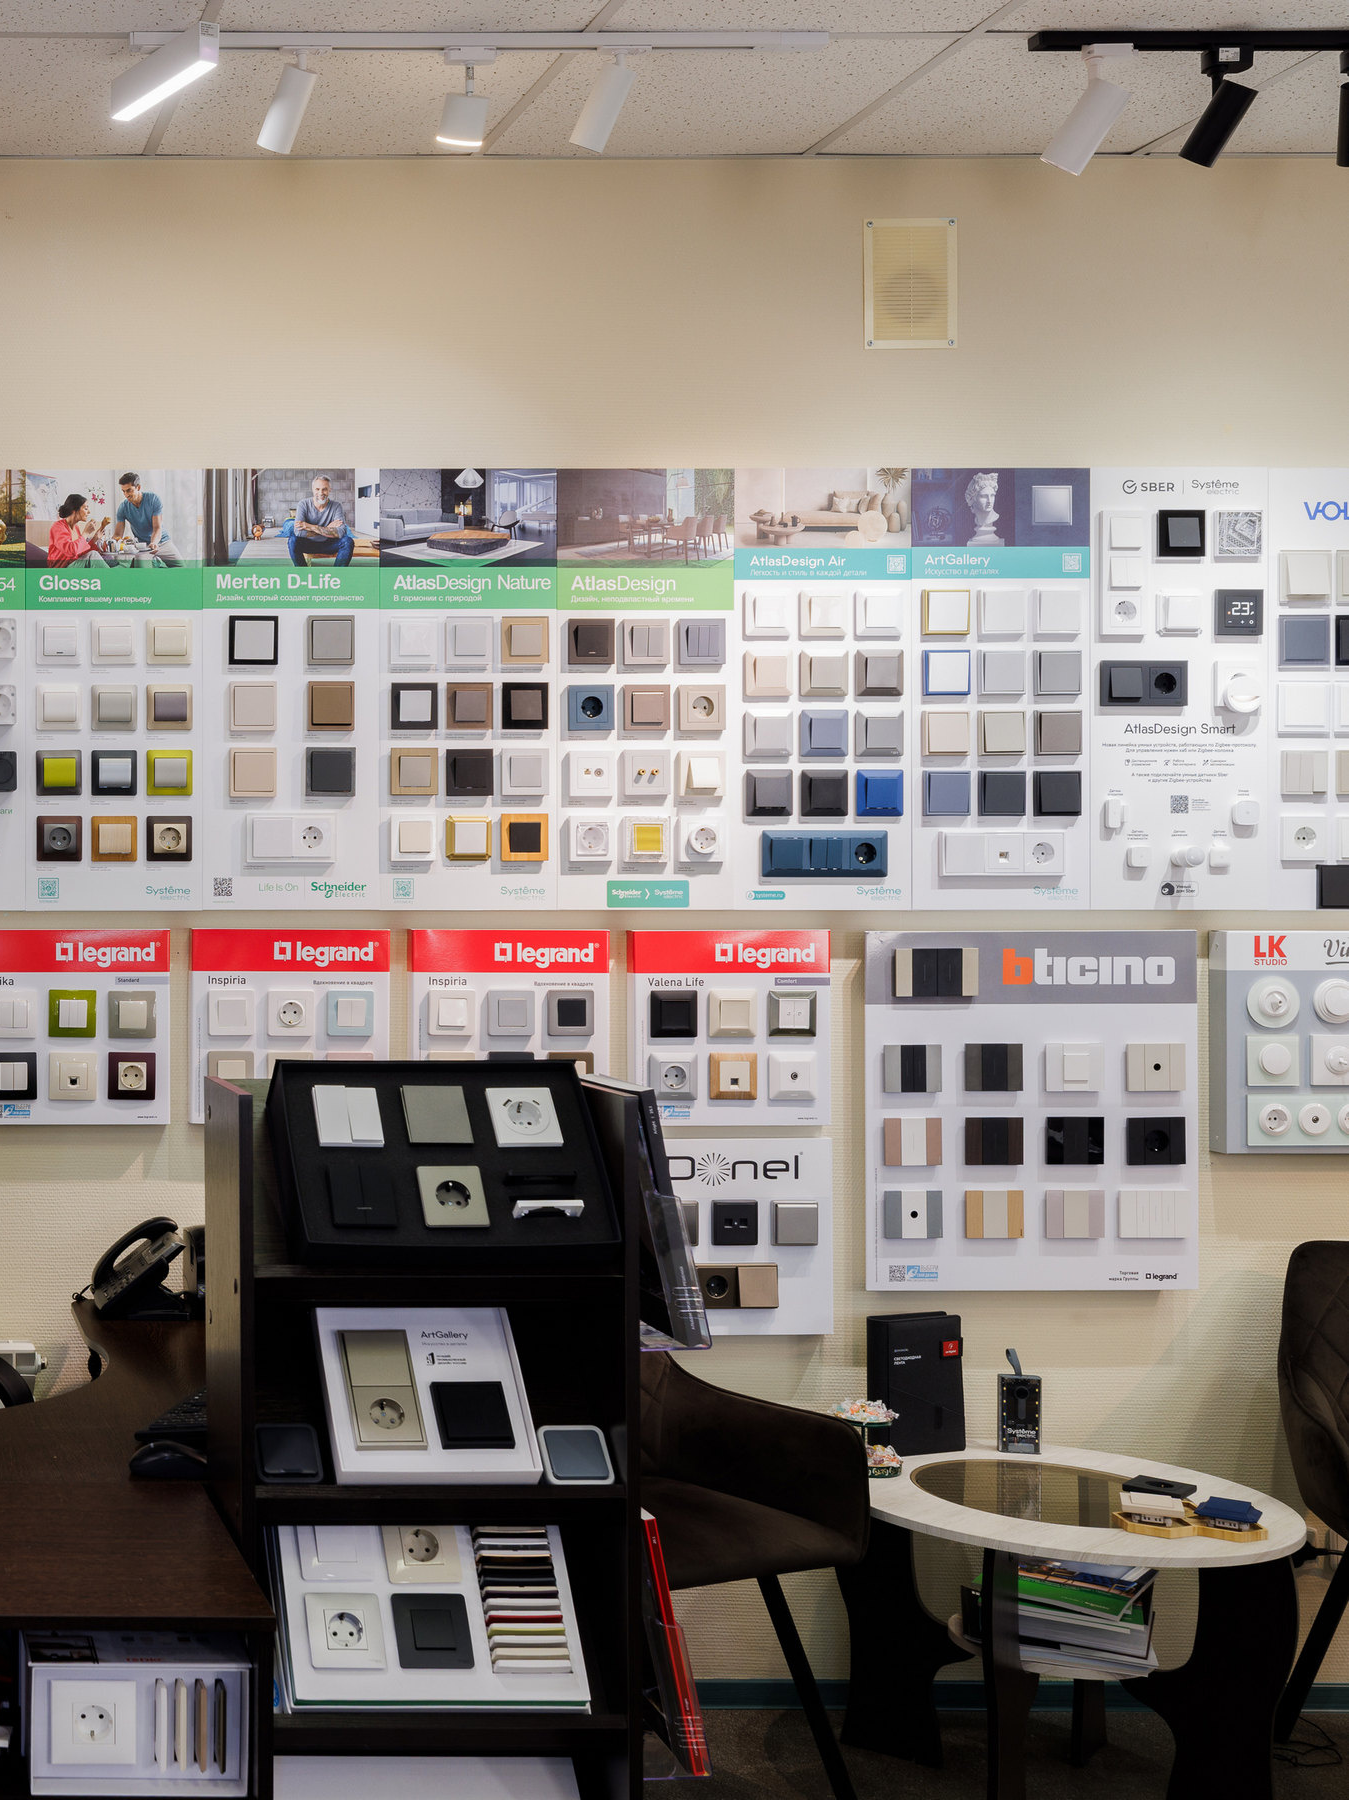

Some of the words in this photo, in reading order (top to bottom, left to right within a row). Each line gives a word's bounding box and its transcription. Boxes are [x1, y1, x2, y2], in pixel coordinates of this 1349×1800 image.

[1140, 482, 1175, 492] SBER
[1191, 480, 1239, 490] Système
[750, 555, 826, 568] AtlasDesign
[829, 555, 846, 567] Air
[924, 554, 991, 568] ArtGallery
[816, 569, 841, 577] каждой
[924, 568, 959, 576] Искусство
[39, 575, 102, 591] Glossa
[216, 574, 281, 590] Merten
[287, 574, 341, 590] D-Life
[393, 575, 492, 593] AtlasDesign
[497, 575, 552, 591] Nature
[571, 575, 676, 594] AtlasDesign
[84, 597, 113, 605] вашему
[114, 597, 152, 605] интерьеру
[247, 594, 278, 603] который
[312, 595, 365, 603] пространство
[400, 596, 437, 604] гармонии
[445, 594, 482, 604] природой
[601, 595, 660, 604] неподвластный
[661, 596, 694, 604] времени
[1124, 723, 1197, 735] AtlasDesign
[1200, 723, 1236, 734] Smart
[145, 885, 191, 897] Système
[258, 882, 273, 892] Life
[275, 882, 282, 892] Is
[284, 882, 299, 892] On
[310, 881, 367, 892] Schneider
[500, 885, 546, 897] Système
[856, 886, 902, 897] Système
[1033, 886, 1079, 897] Système
[611, 889, 642, 898] Schneider
[654, 888, 684, 897] Système
[1254, 936, 1287, 957] LK
[78, 941, 156, 968] legrand
[296, 941, 374, 967] legrand
[517, 942, 594, 969] legrand
[737, 943, 815, 969] legrand
[1002, 948, 1176, 985] bticino
[1254, 958, 1288, 966] STUDIO
[207, 976, 246, 987] Inspiria
[428, 977, 467, 988] Inspiria
[648, 978, 682, 987] Valena
[684, 978, 704, 987] Life
[1152, 1273, 1177, 1282] legrand
[420, 1330, 468, 1340] ArtGallery
